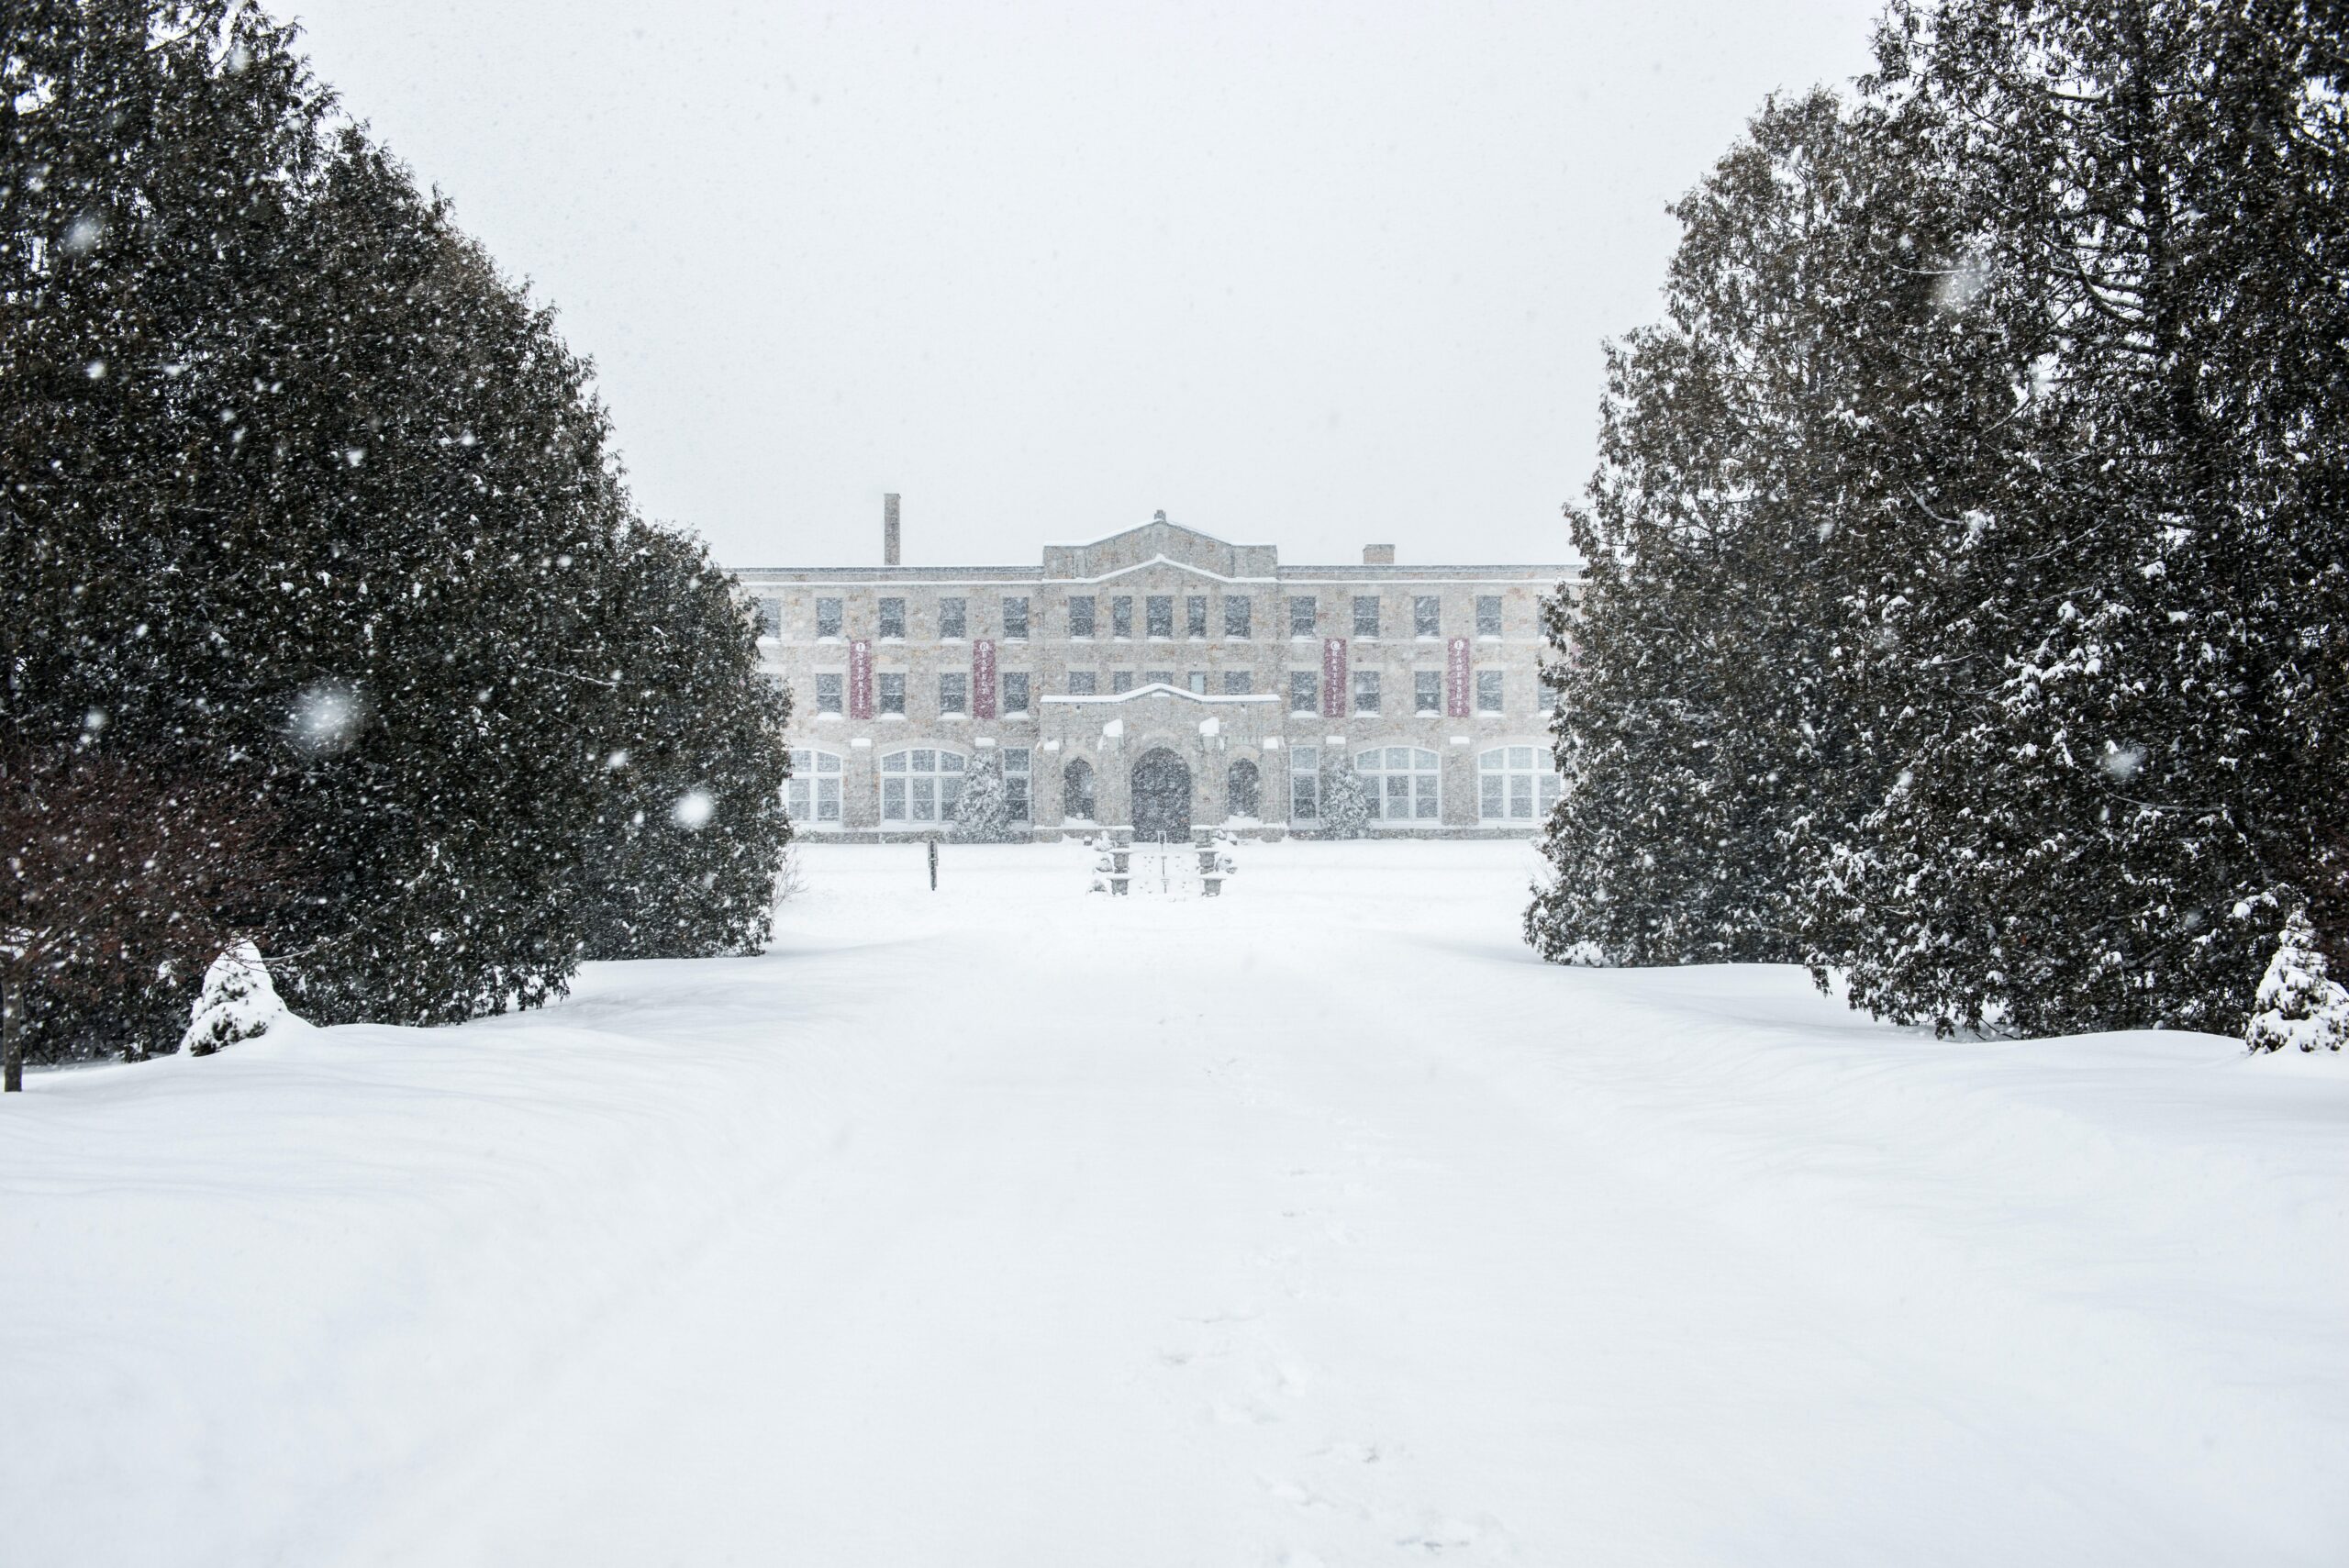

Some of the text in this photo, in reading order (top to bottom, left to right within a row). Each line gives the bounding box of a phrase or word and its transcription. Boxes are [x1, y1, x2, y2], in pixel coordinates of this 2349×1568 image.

[857, 642, 865, 709] INTEGRITY
[1331, 642, 1340, 715] CREATIVITY
[1455, 641, 1464, 714] LEADERSHIP
